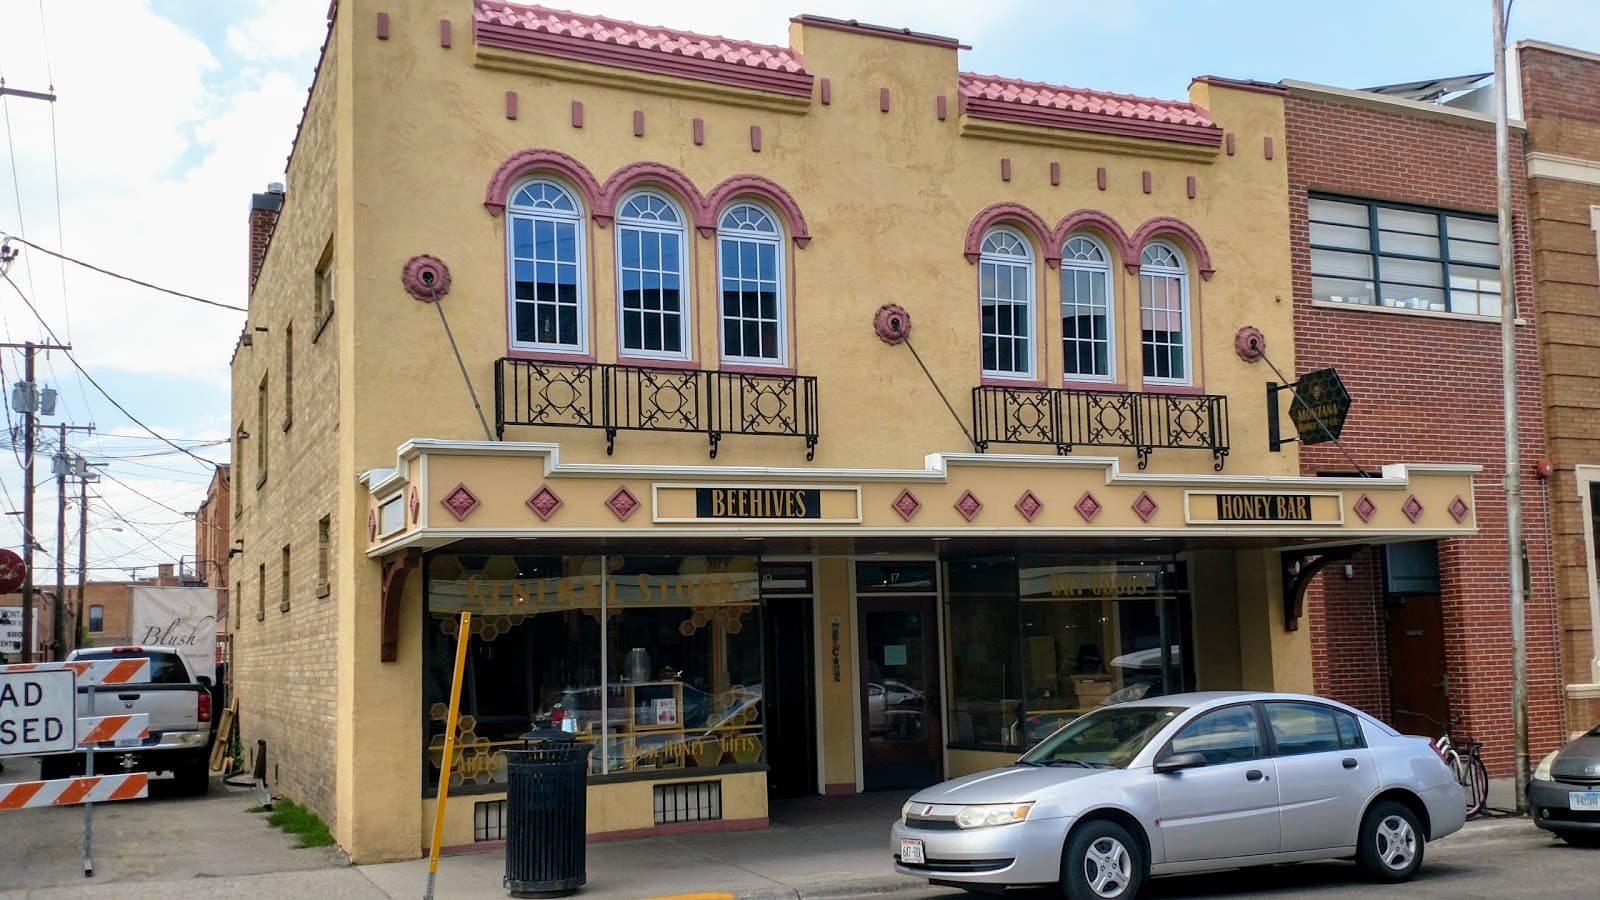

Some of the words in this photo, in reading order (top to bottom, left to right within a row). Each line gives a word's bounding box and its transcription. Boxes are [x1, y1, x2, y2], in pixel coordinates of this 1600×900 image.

[711, 489, 807, 517] BEEHIVES
[1221, 495, 1270, 519] HONEY
[1276, 496, 1307, 519] BAR
[141, 615, 215, 646] Blush
[721, 736, 755, 753] GIFTS
